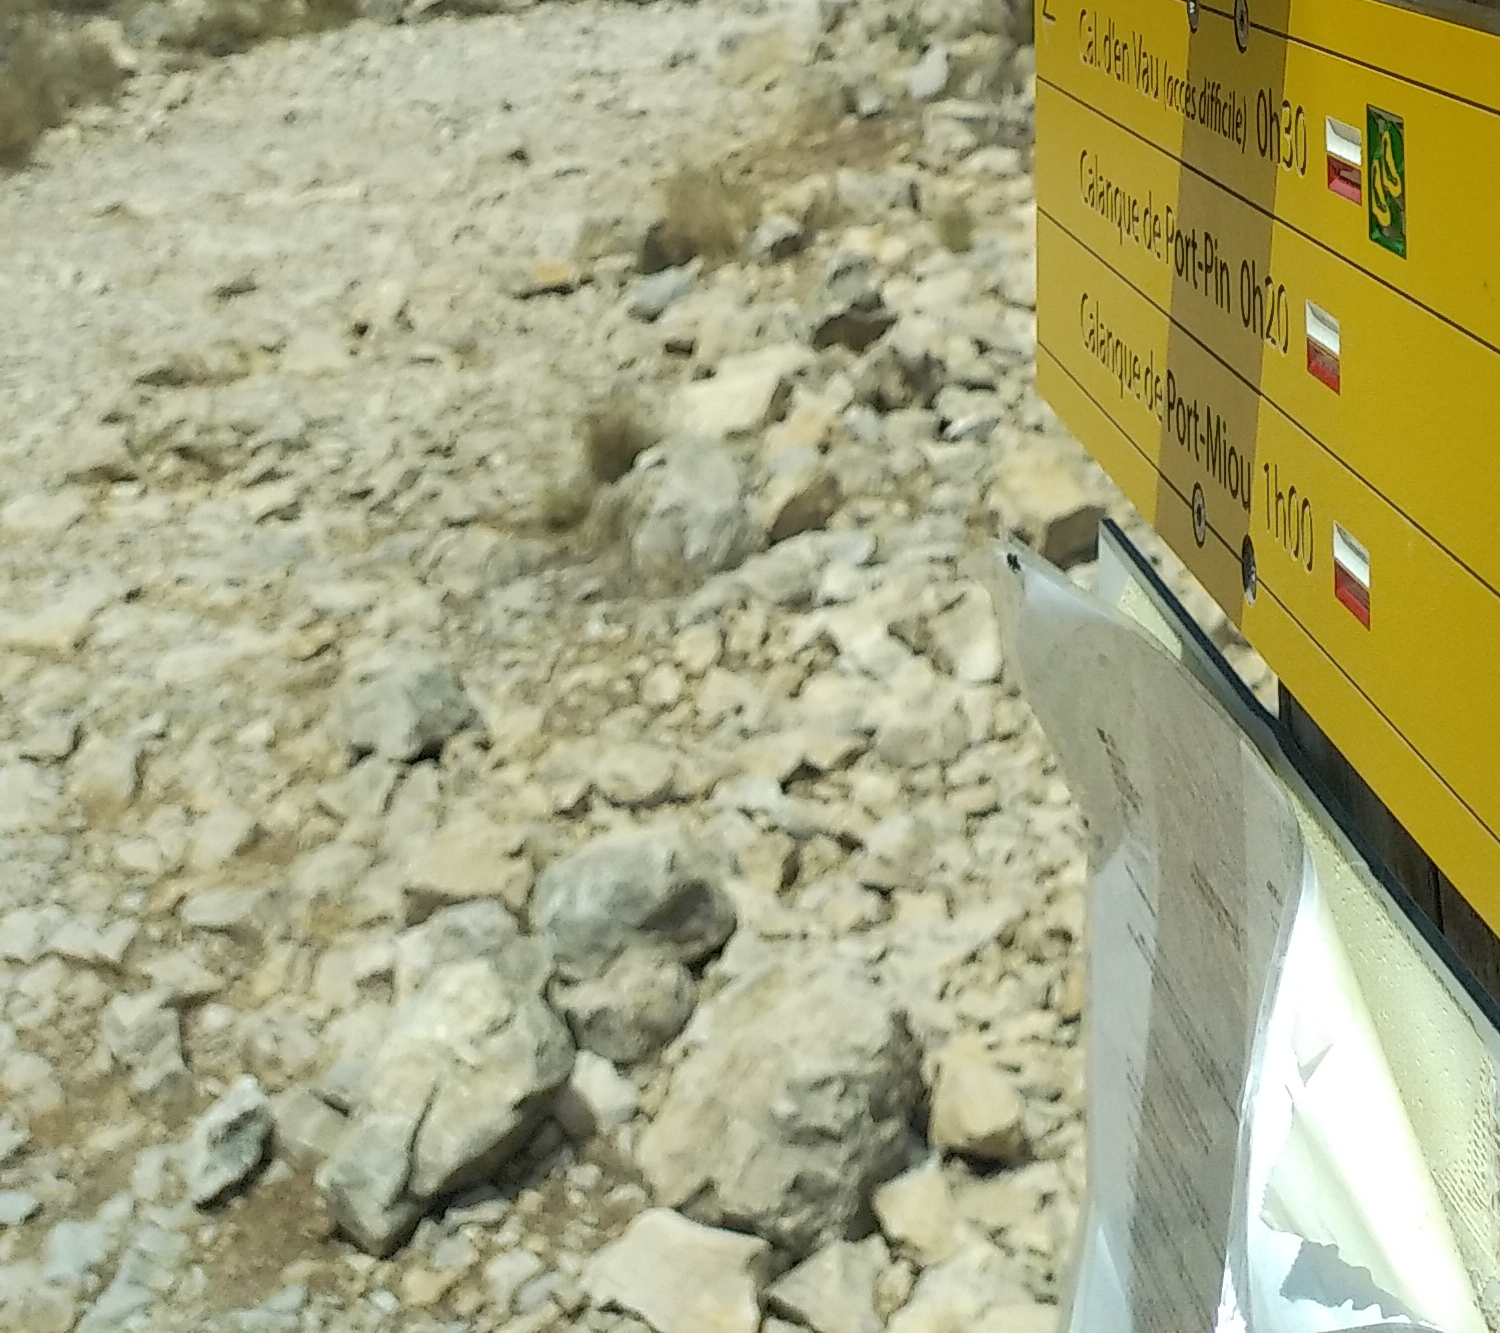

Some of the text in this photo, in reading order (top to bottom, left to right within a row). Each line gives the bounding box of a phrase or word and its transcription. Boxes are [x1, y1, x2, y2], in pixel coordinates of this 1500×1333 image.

[1103, 17, 1130, 85] d'en
[1132, 30, 1160, 101] Vau
[1199, 76, 1248, 155] difficile)
[1256, 86, 1308, 177] 0h30
[1079, 149, 1290, 355] Calanque de Port-Pin 0h20
[1079, 292, 1315, 574] Calanque de Port-Miou 1h00
